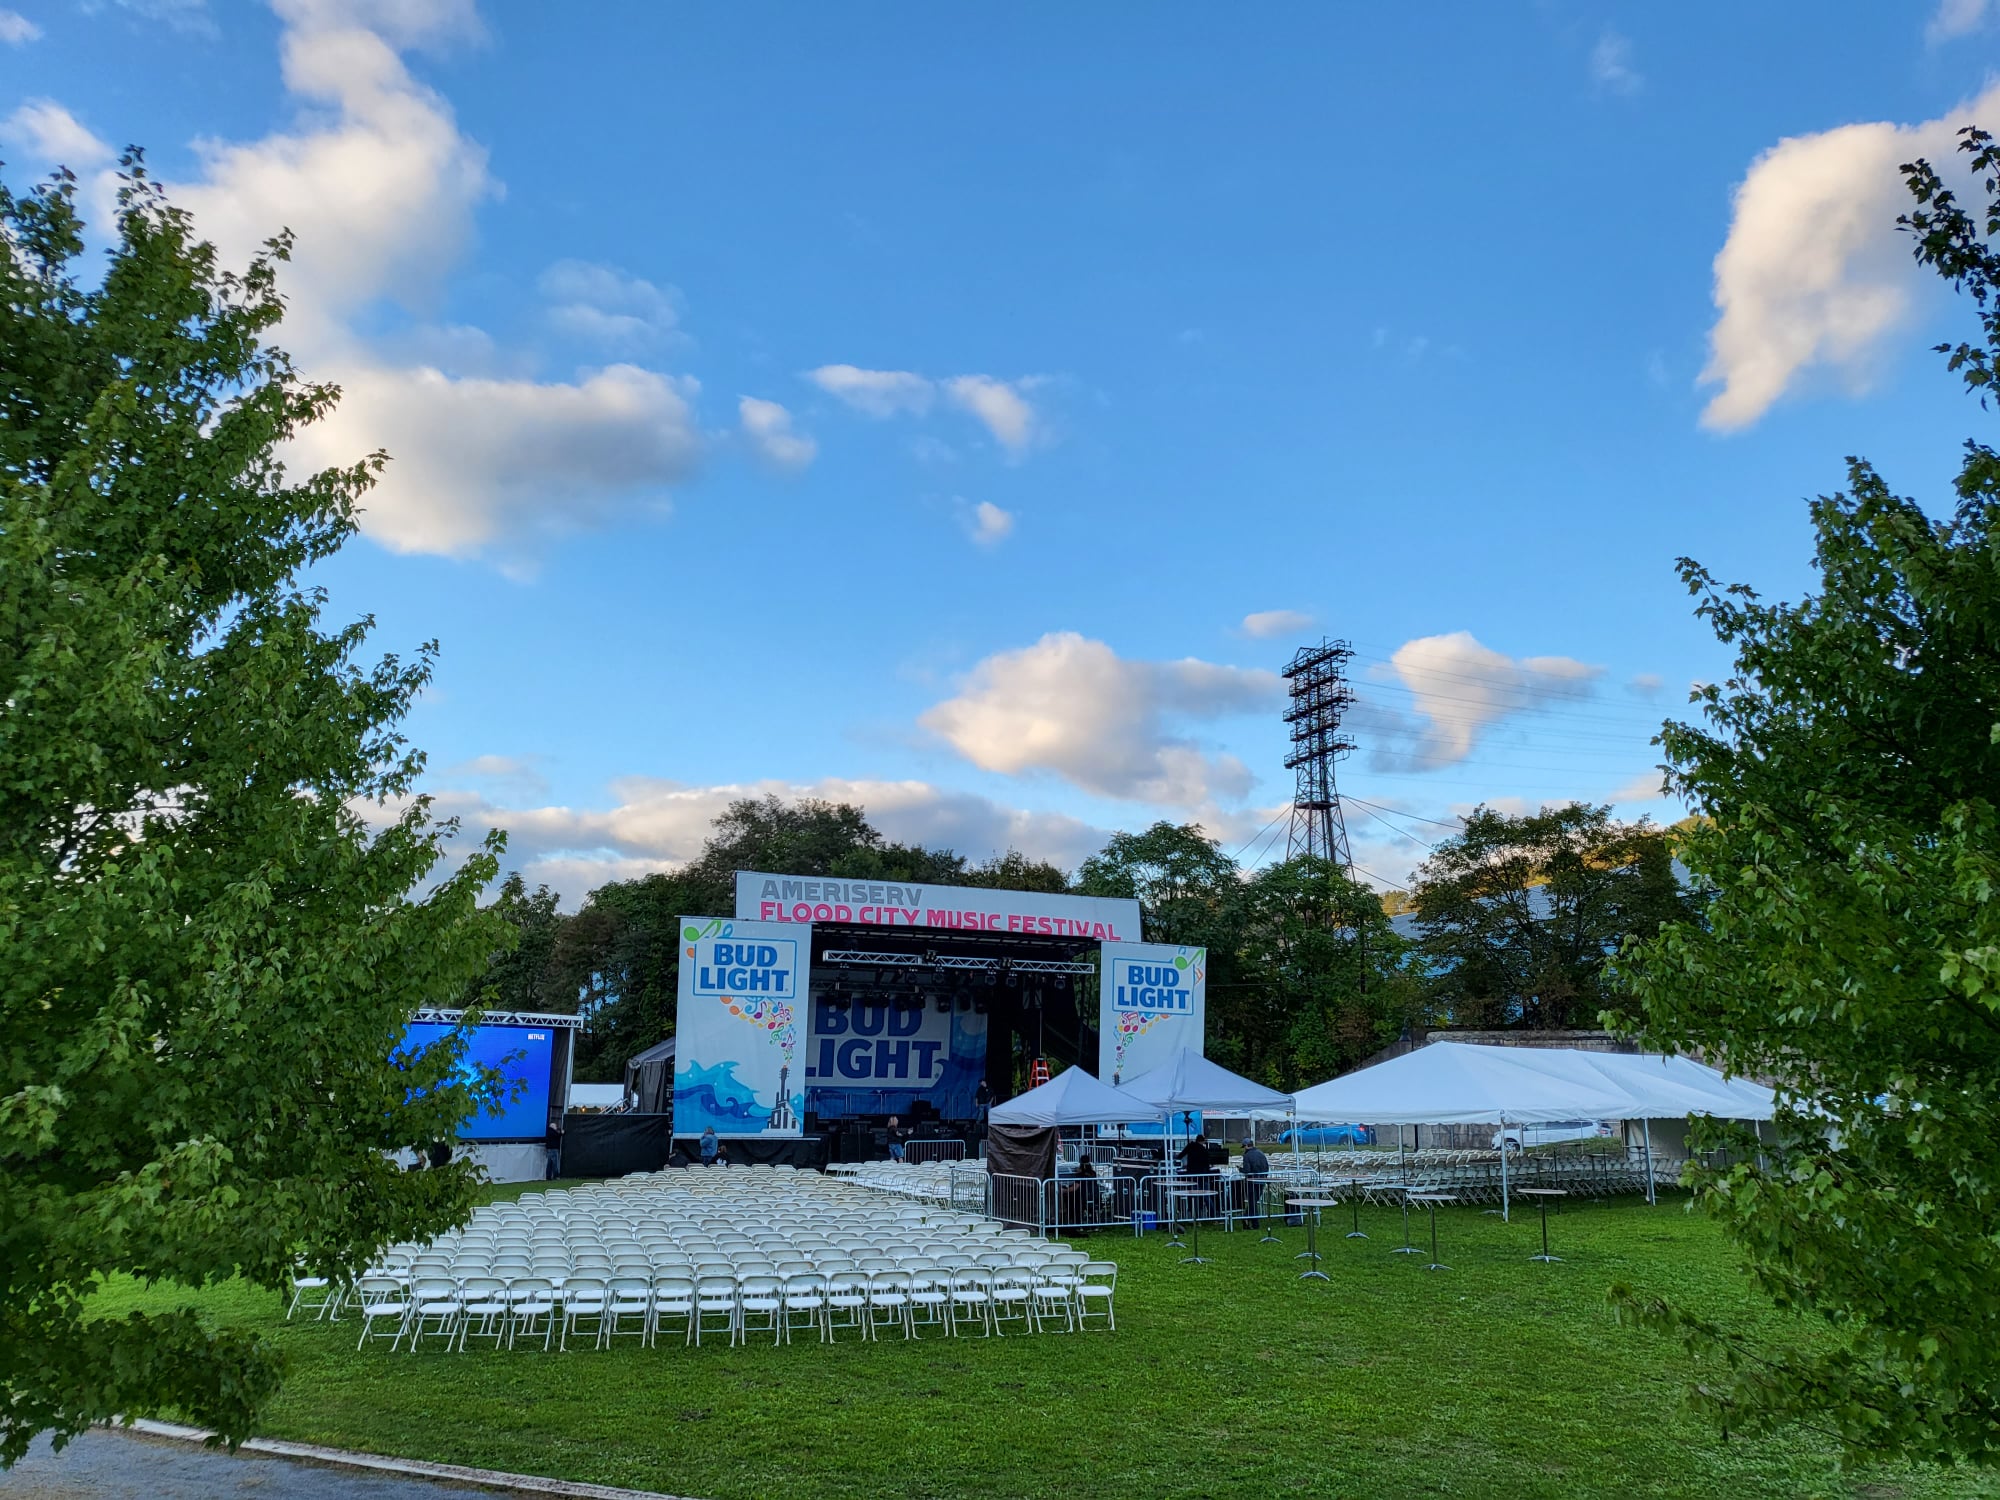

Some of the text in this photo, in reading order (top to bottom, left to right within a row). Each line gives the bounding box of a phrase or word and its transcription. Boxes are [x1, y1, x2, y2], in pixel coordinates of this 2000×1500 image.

[760, 879, 923, 907] AMERISERV
[760, 901, 1121, 941] FLOOD CITY MUSIC FESTIVAL
[713, 943, 778, 967] BUD
[700, 966, 790, 992] LIGHT
[1128, 965, 1180, 988] BUD
[1117, 986, 1190, 1010] LIGHT
[814, 994, 923, 1037] BUD
